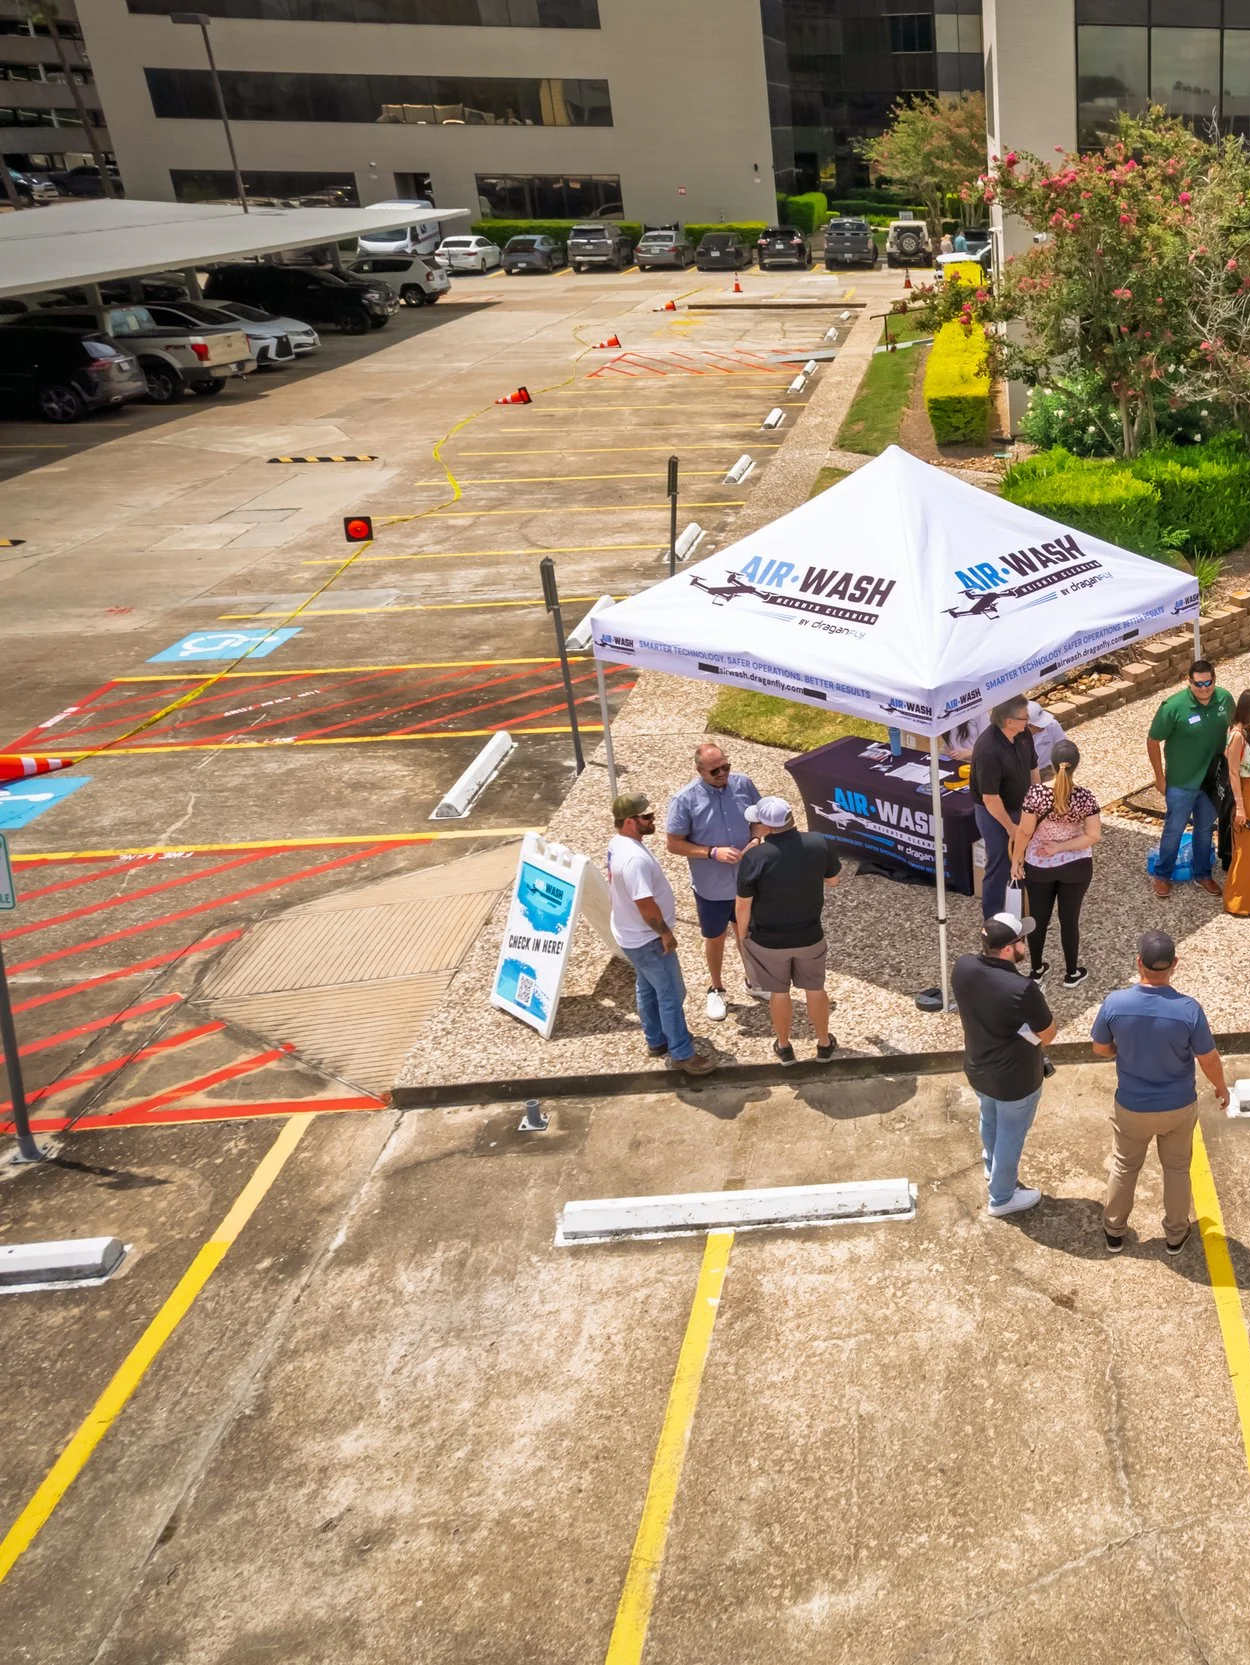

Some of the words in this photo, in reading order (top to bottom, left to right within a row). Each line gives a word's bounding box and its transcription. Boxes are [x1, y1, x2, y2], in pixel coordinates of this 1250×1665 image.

[775, 596, 820, 613] HEIGHTS
[825, 607, 877, 624] CLEANING
[798, 618, 810, 627] BY
[985, 668, 1018, 691] SMARTER
[1063, 635, 1082, 653] SAFER
[1057, 635, 1123, 668] airwash.draganfly.com
[639, 639, 672, 654] SMARTER
[673, 646, 726, 664] TECHNOLOGY.
[727, 656, 751, 669] SAFER
[752, 661, 803, 682] OPERATIONS.
[804, 675, 835, 690] BETTER
[835, 683, 871, 700] RESULTS
[718, 666, 804, 694] airwash.draganfly.com
[508, 934, 531, 951] CHECK
[532, 938, 541, 952] IN
[541, 939, 564, 955] HERE!
